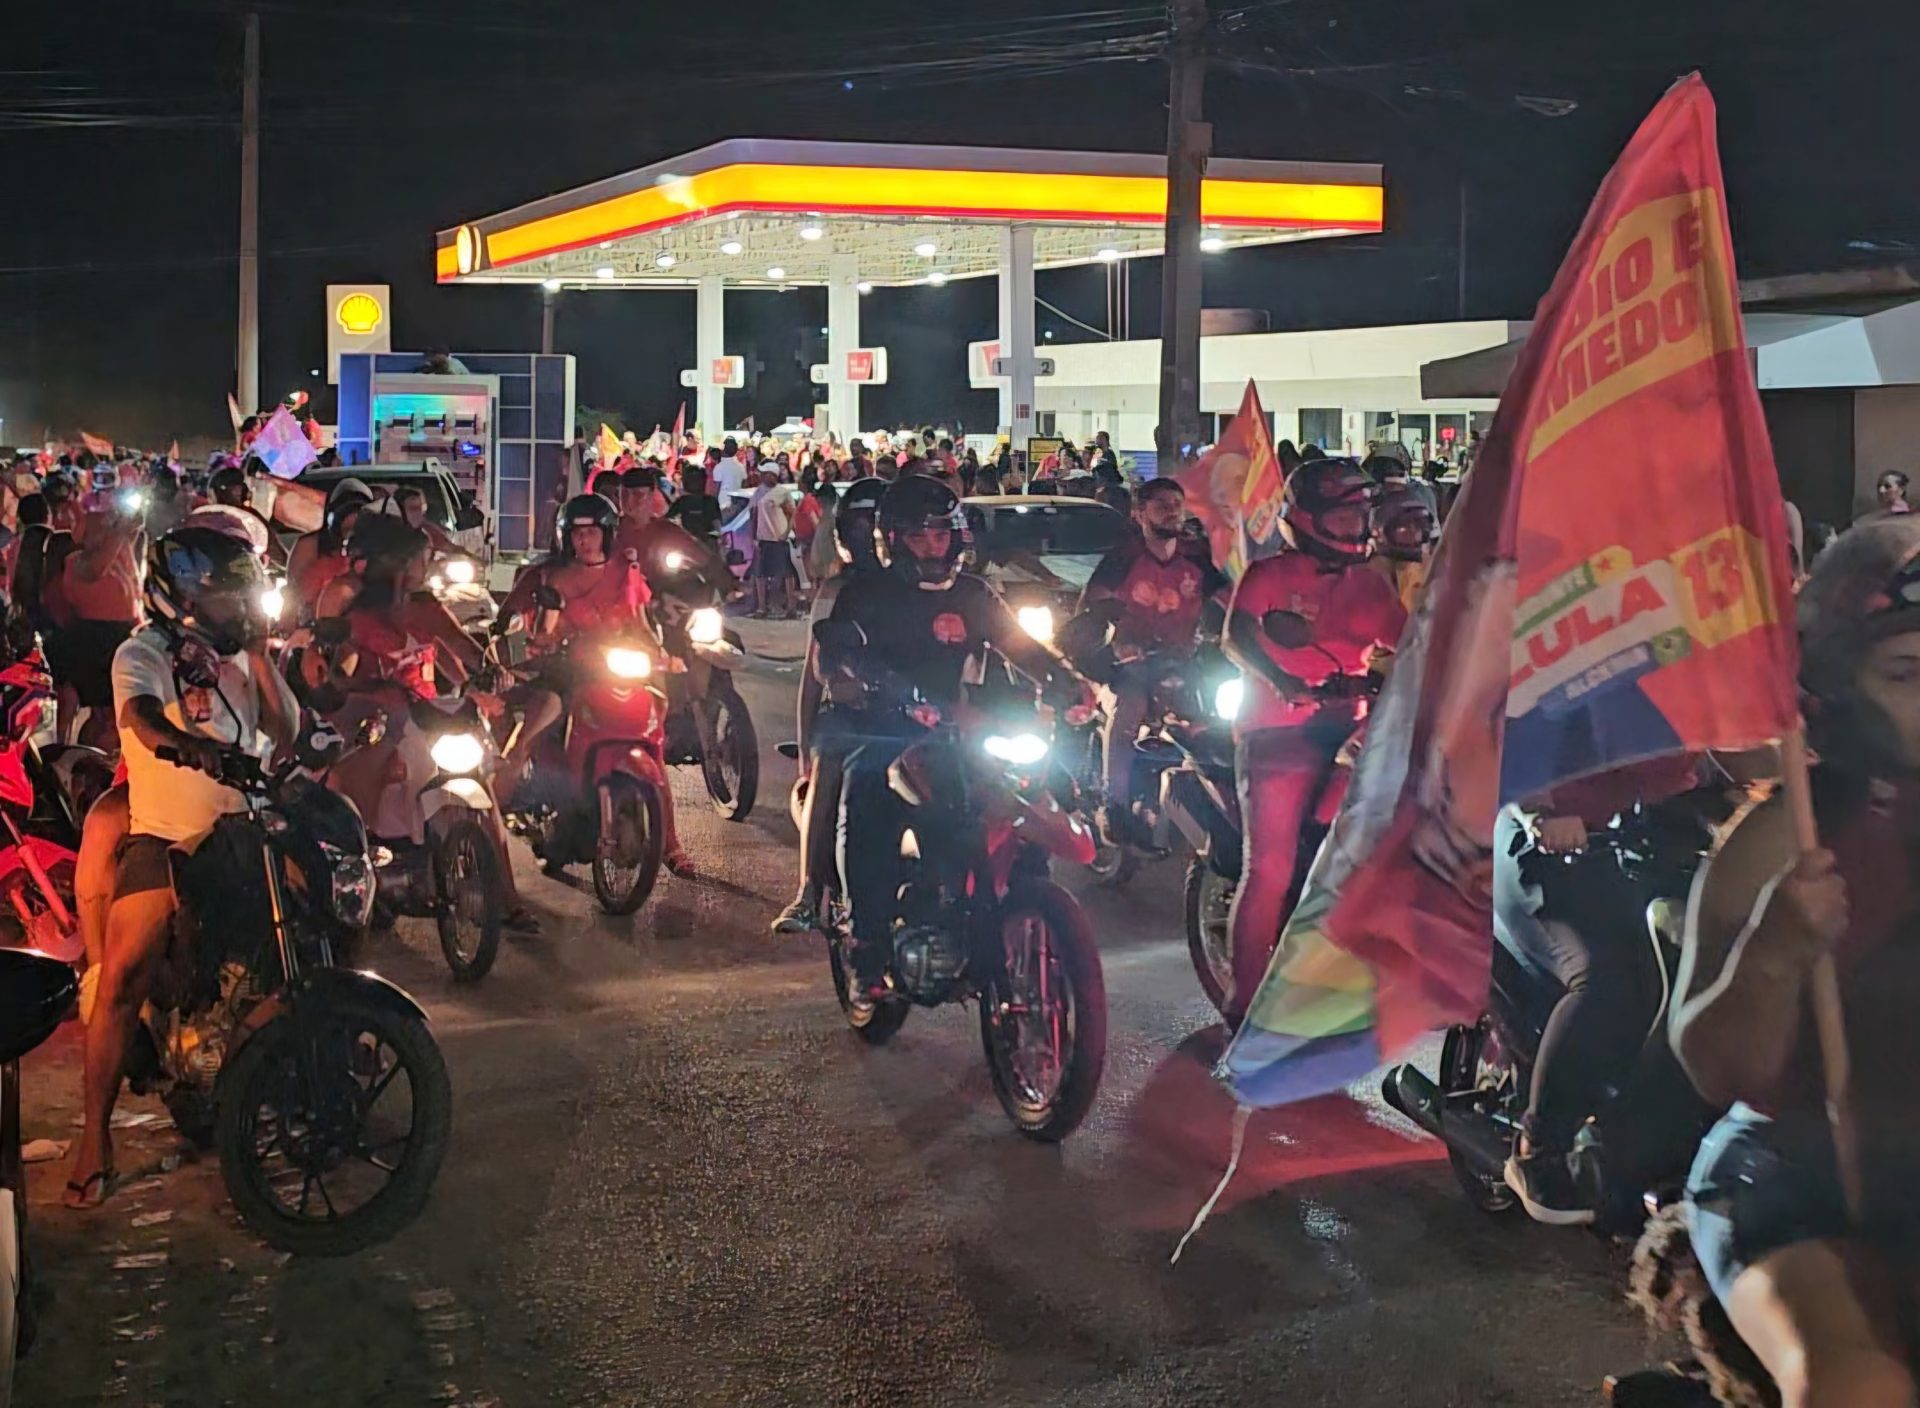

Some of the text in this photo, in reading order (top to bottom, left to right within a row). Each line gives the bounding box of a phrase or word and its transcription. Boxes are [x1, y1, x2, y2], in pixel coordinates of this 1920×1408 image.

[1041, 361, 1050, 374] 2
[1538, 281, 1700, 420] MEDO
[1684, 539, 1744, 621] 13
